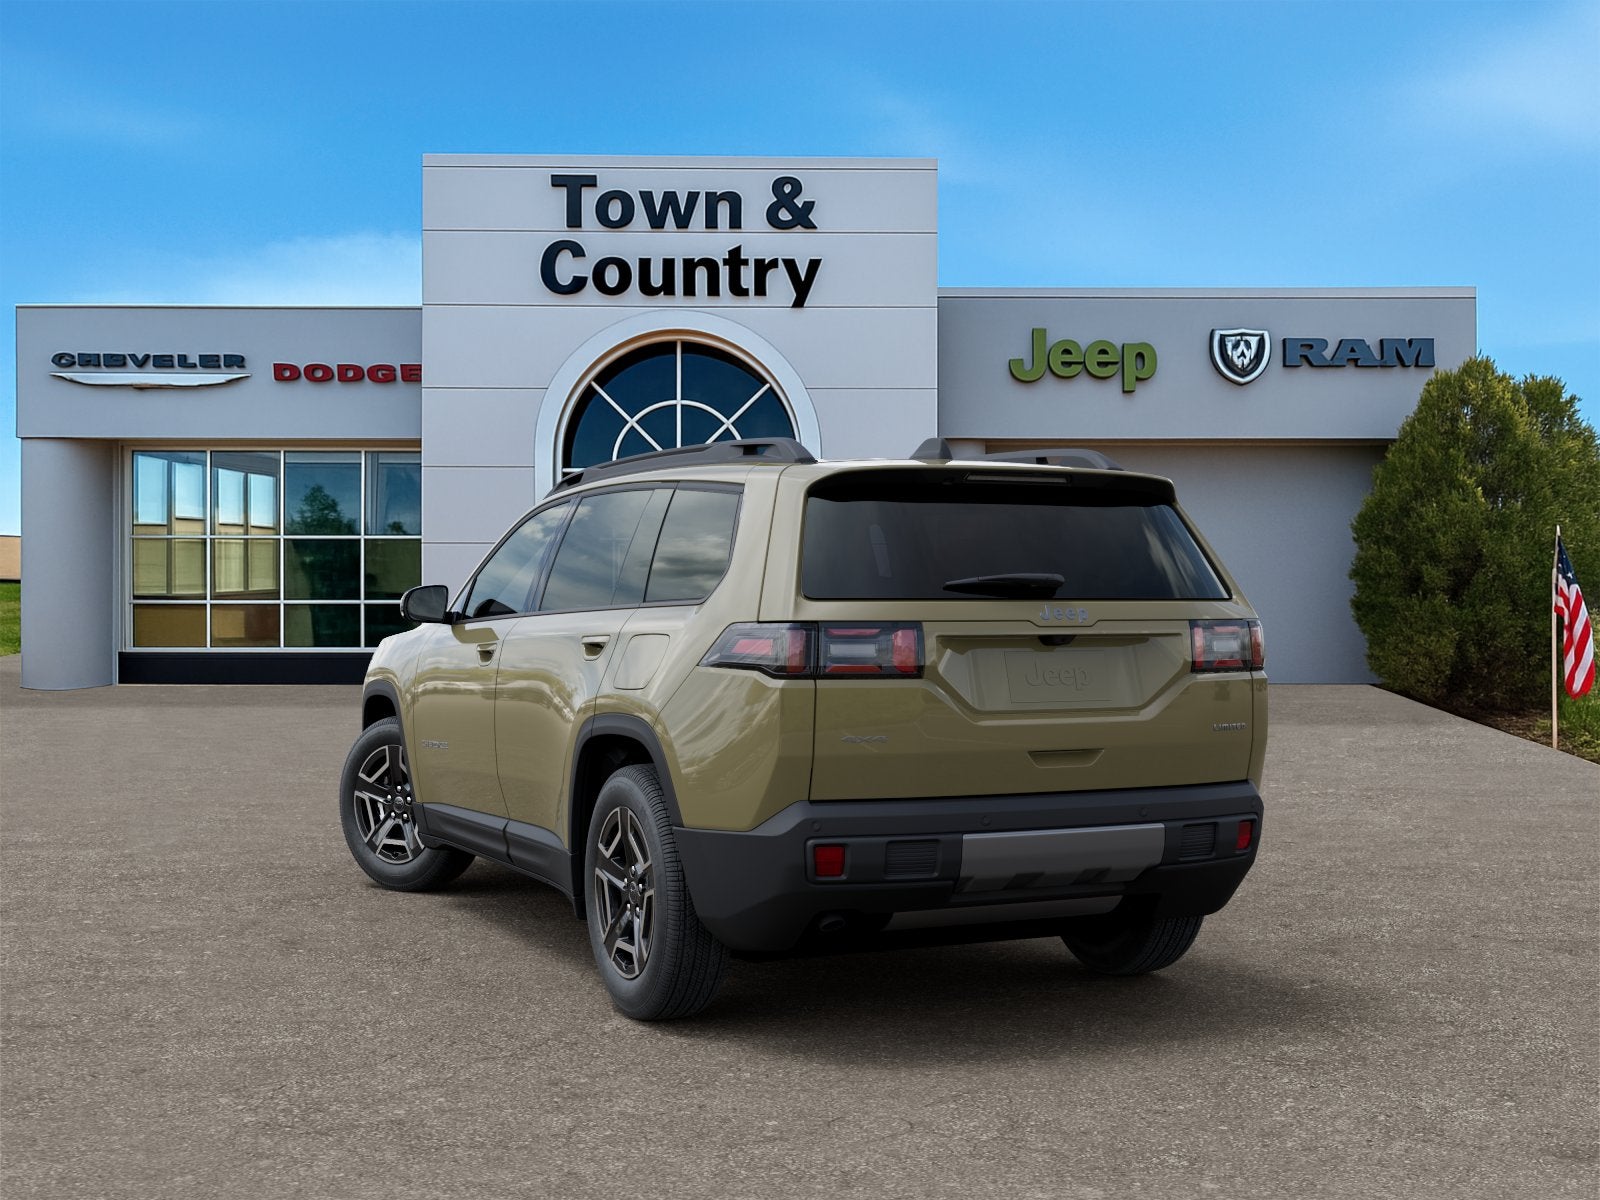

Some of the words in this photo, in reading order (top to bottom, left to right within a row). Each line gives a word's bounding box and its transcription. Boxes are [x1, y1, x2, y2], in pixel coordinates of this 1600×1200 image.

[551, 174, 742, 229] Town
[765, 176, 818, 230] &
[540, 239, 822, 308] Country
[1009, 327, 1157, 392] Jeep
[1282, 337, 1435, 367] RAM
[273, 363, 421, 382] DODGE
[1039, 605, 1089, 623] Jeep
[1025, 657, 1090, 691] Jeep
